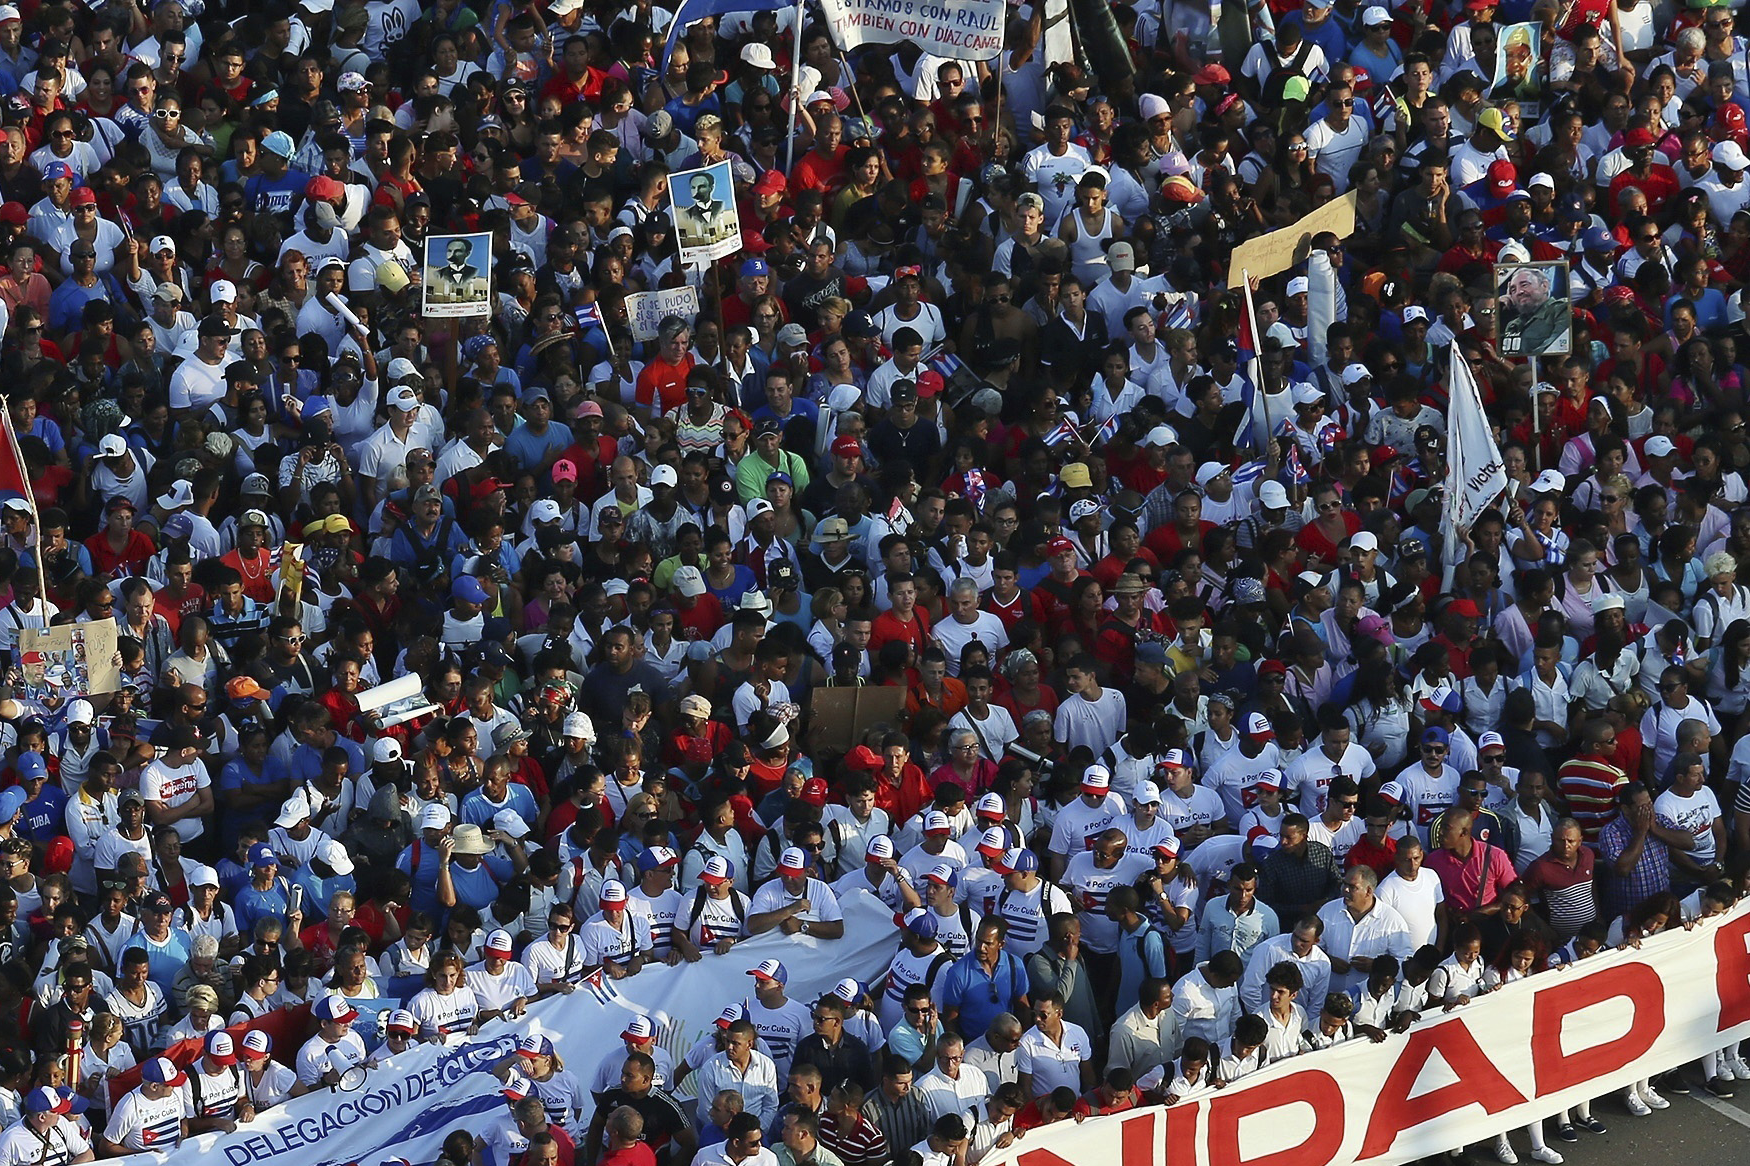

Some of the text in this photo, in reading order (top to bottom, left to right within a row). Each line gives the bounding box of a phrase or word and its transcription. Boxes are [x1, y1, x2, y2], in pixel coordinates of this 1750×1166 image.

[920, 5, 951, 20] CON
[956, 9, 998, 31] RAÚL
[833, 13, 931, 38] TAMBIÉN CON
[665, 293, 691, 308] PUDO
[1502, 337, 1522, 351] 90
[160, 778, 198, 794] Supreme
[1192, 812, 1209, 820] Cuba
[1337, 843, 1353, 851] Cuba
[1021, 906, 1038, 916] Cuba
[721, 914, 738, 923] Cuba
[906, 970, 920, 981] Cuba
[454, 1008, 470, 1016] Cuba
[771, 1024, 790, 1033] Cuba
[402, 1065, 437, 1100] DE
[441, 1035, 520, 1085] CUBA
[221, 1085, 237, 1096] Cuba
[546, 1096, 564, 1104] Cuba
[161, 1107, 176, 1118] Cuba
